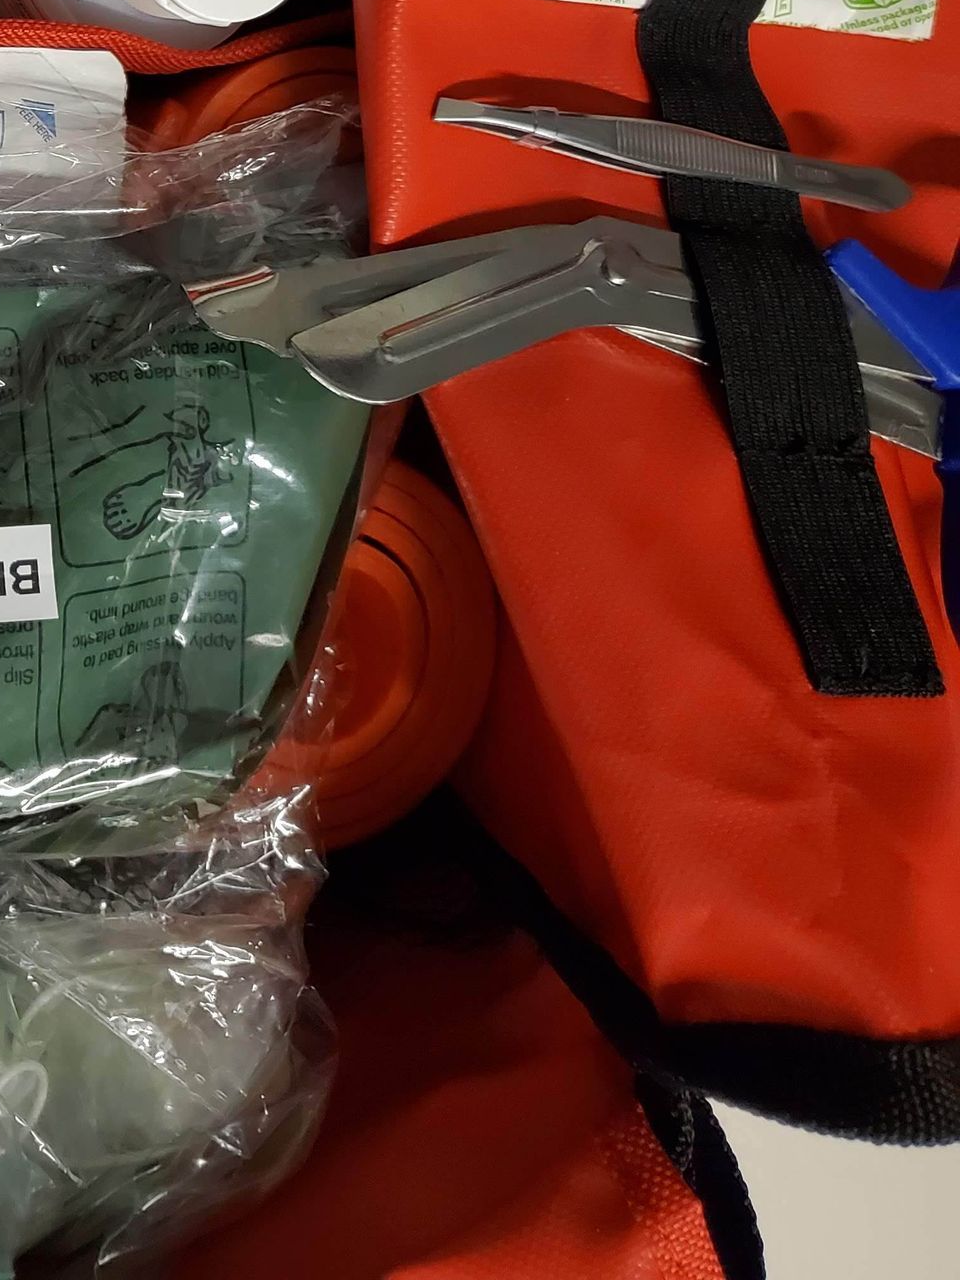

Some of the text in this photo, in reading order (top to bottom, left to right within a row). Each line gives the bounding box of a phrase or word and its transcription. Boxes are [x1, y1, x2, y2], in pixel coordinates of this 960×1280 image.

[880, 3, 928, 24] package
[32, 120, 54, 143] HERE
[203, 341, 237, 357] over
[89, 369, 130, 388] back
[207, 363, 241, 380] Fold
[84, 606, 119, 624] limb.
[121, 595, 167, 619] around
[119, 618, 150, 637] wrap
[183, 612, 237, 627] woun
[72, 629, 116, 649] elastic
[189, 633, 236, 651] Apply
[82, 655, 96, 669] to
[100, 645, 125, 663] pad
[3, 666, 35, 686] Slip
